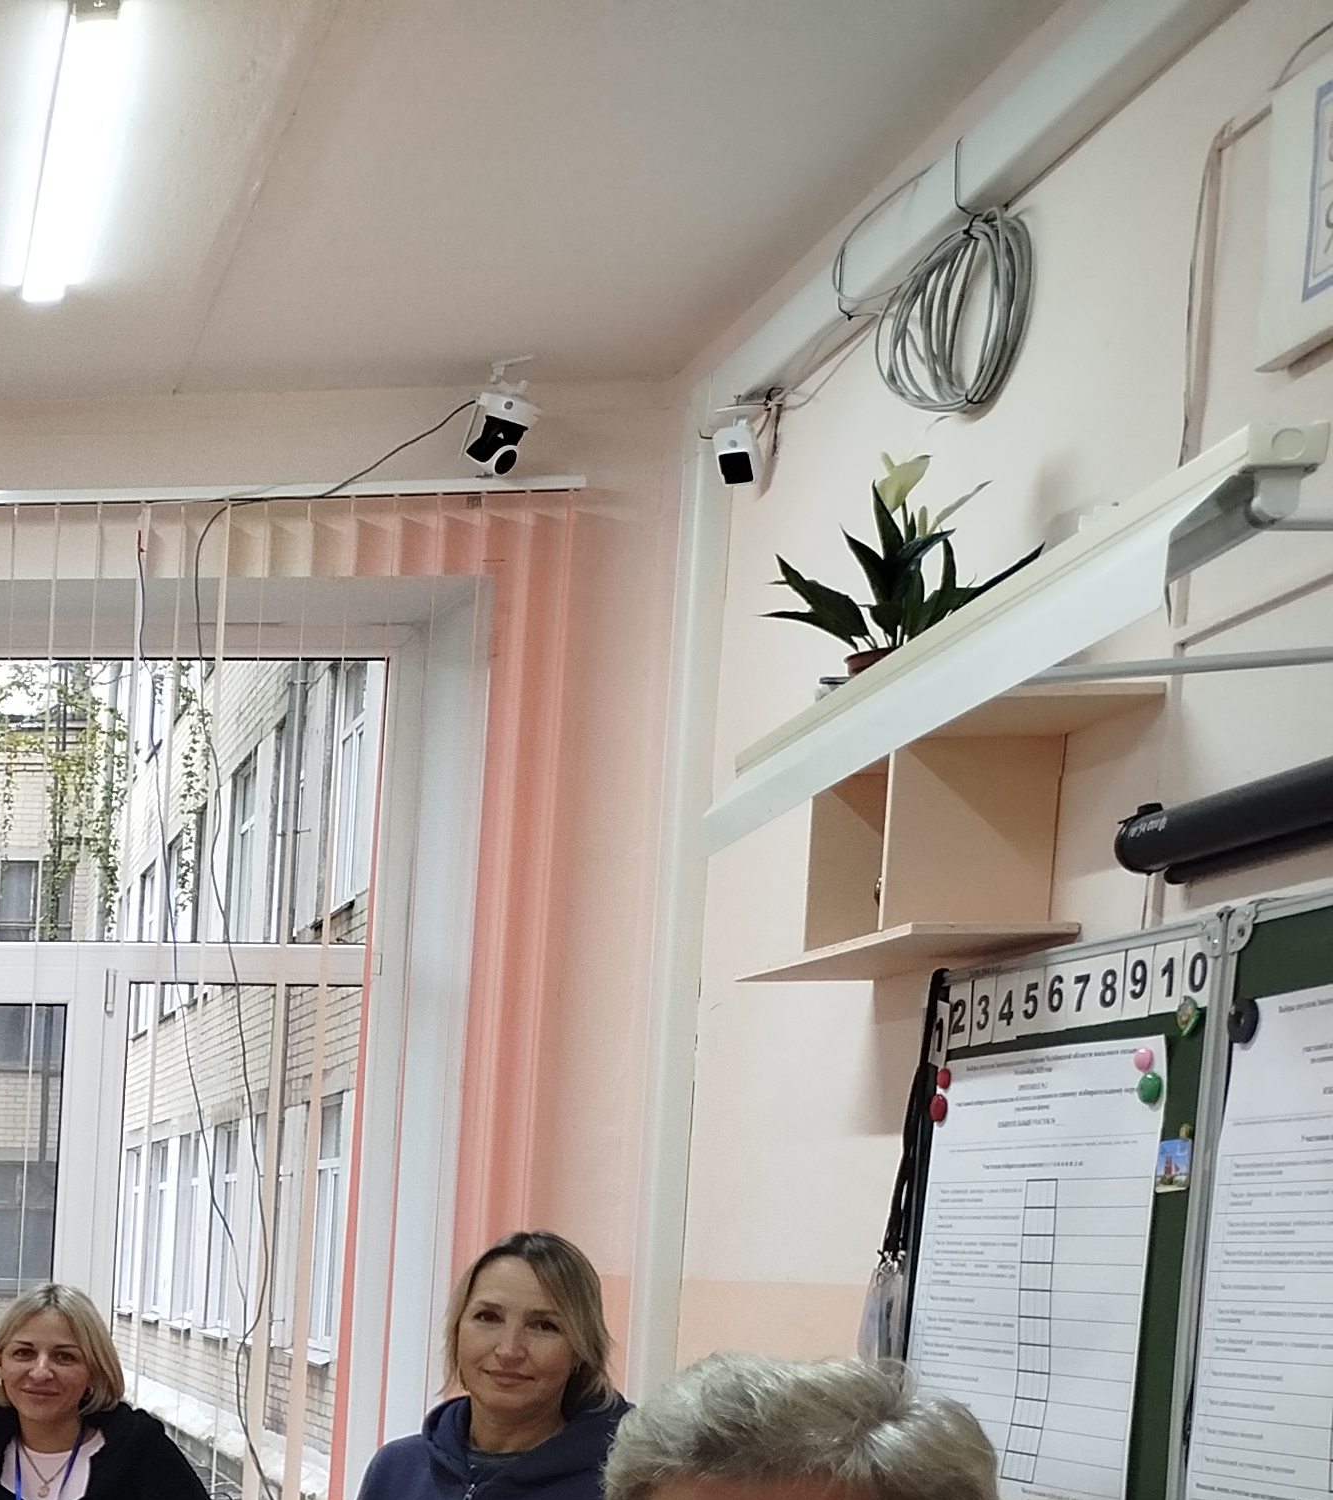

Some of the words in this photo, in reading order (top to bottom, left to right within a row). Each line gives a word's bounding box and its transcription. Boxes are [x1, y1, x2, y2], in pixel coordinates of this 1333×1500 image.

[935, 1018, 944, 1052] 1
[951, 999, 966, 1034] 2
[977, 995, 989, 1031] 3
[998, 990, 1013, 1026] 4
[1022, 983, 1039, 1019] 5
[1048, 975, 1064, 1012] 6
[1074, 974, 1090, 1012] 7
[1099, 969, 1117, 1008] 8
[1130, 960, 1147, 999] 9
